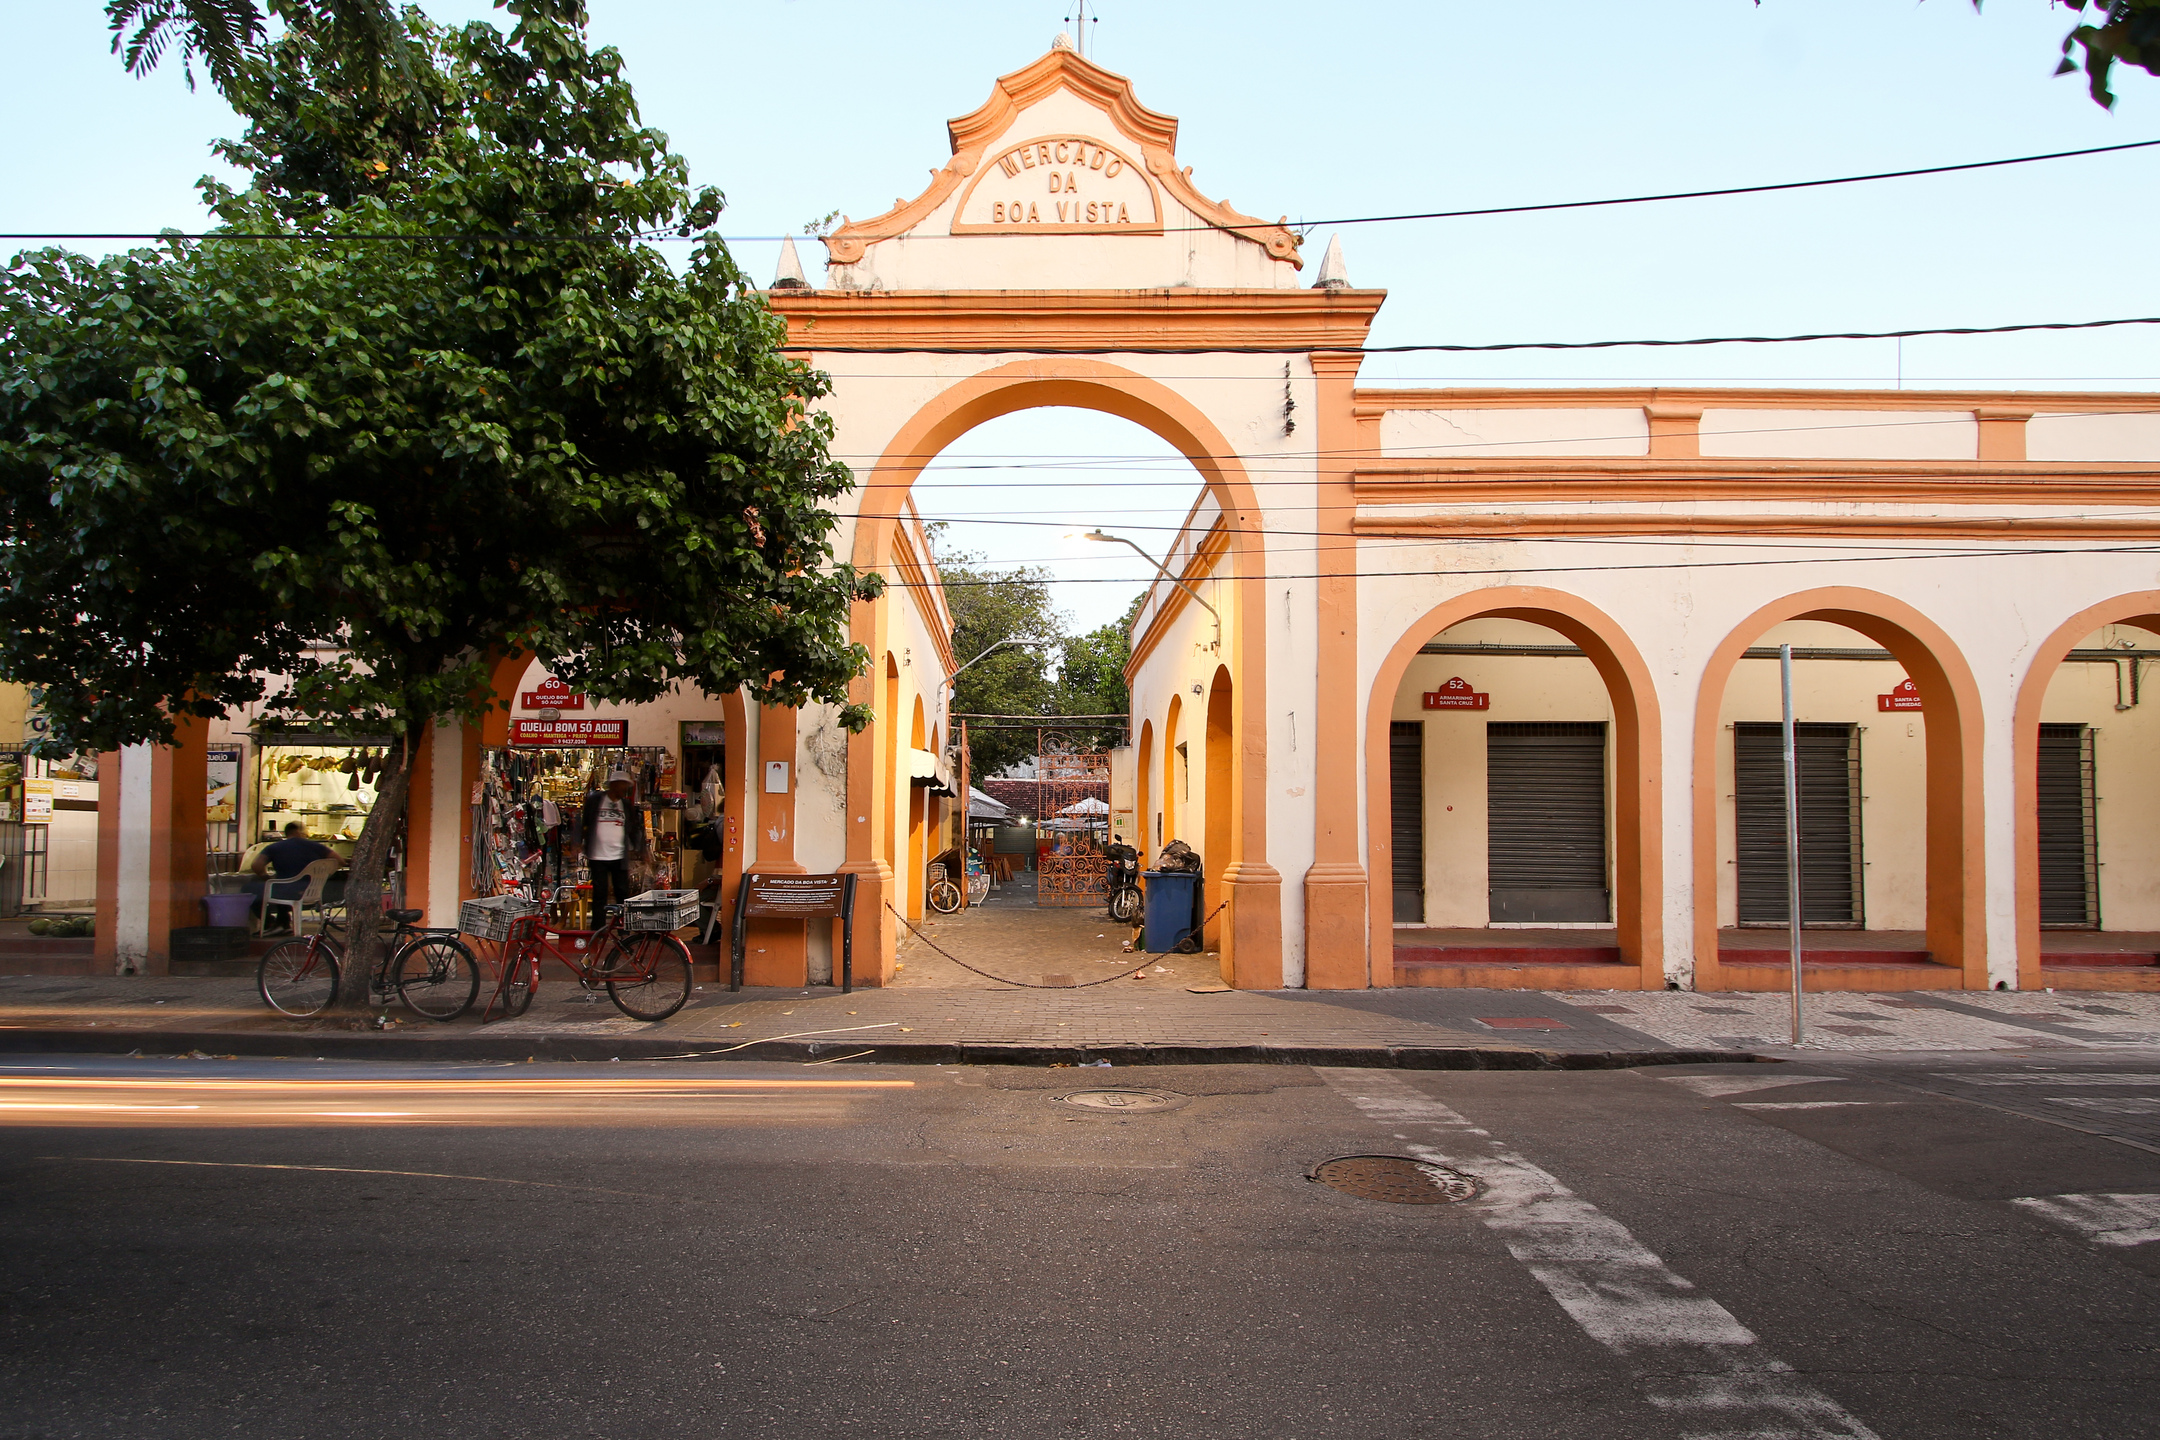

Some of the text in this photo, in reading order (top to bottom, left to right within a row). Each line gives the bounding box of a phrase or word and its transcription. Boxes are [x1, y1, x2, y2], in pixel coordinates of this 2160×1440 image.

[998, 140, 1124, 178] MERCADO
[1049, 171, 1078, 193] DA
[993, 200, 1130, 223] BOA VISTA
[545, 680, 560, 689] 60
[1449, 680, 1464, 689] 52
[520, 721, 620, 733] QUEIJO BOM SÓ AQUI!
